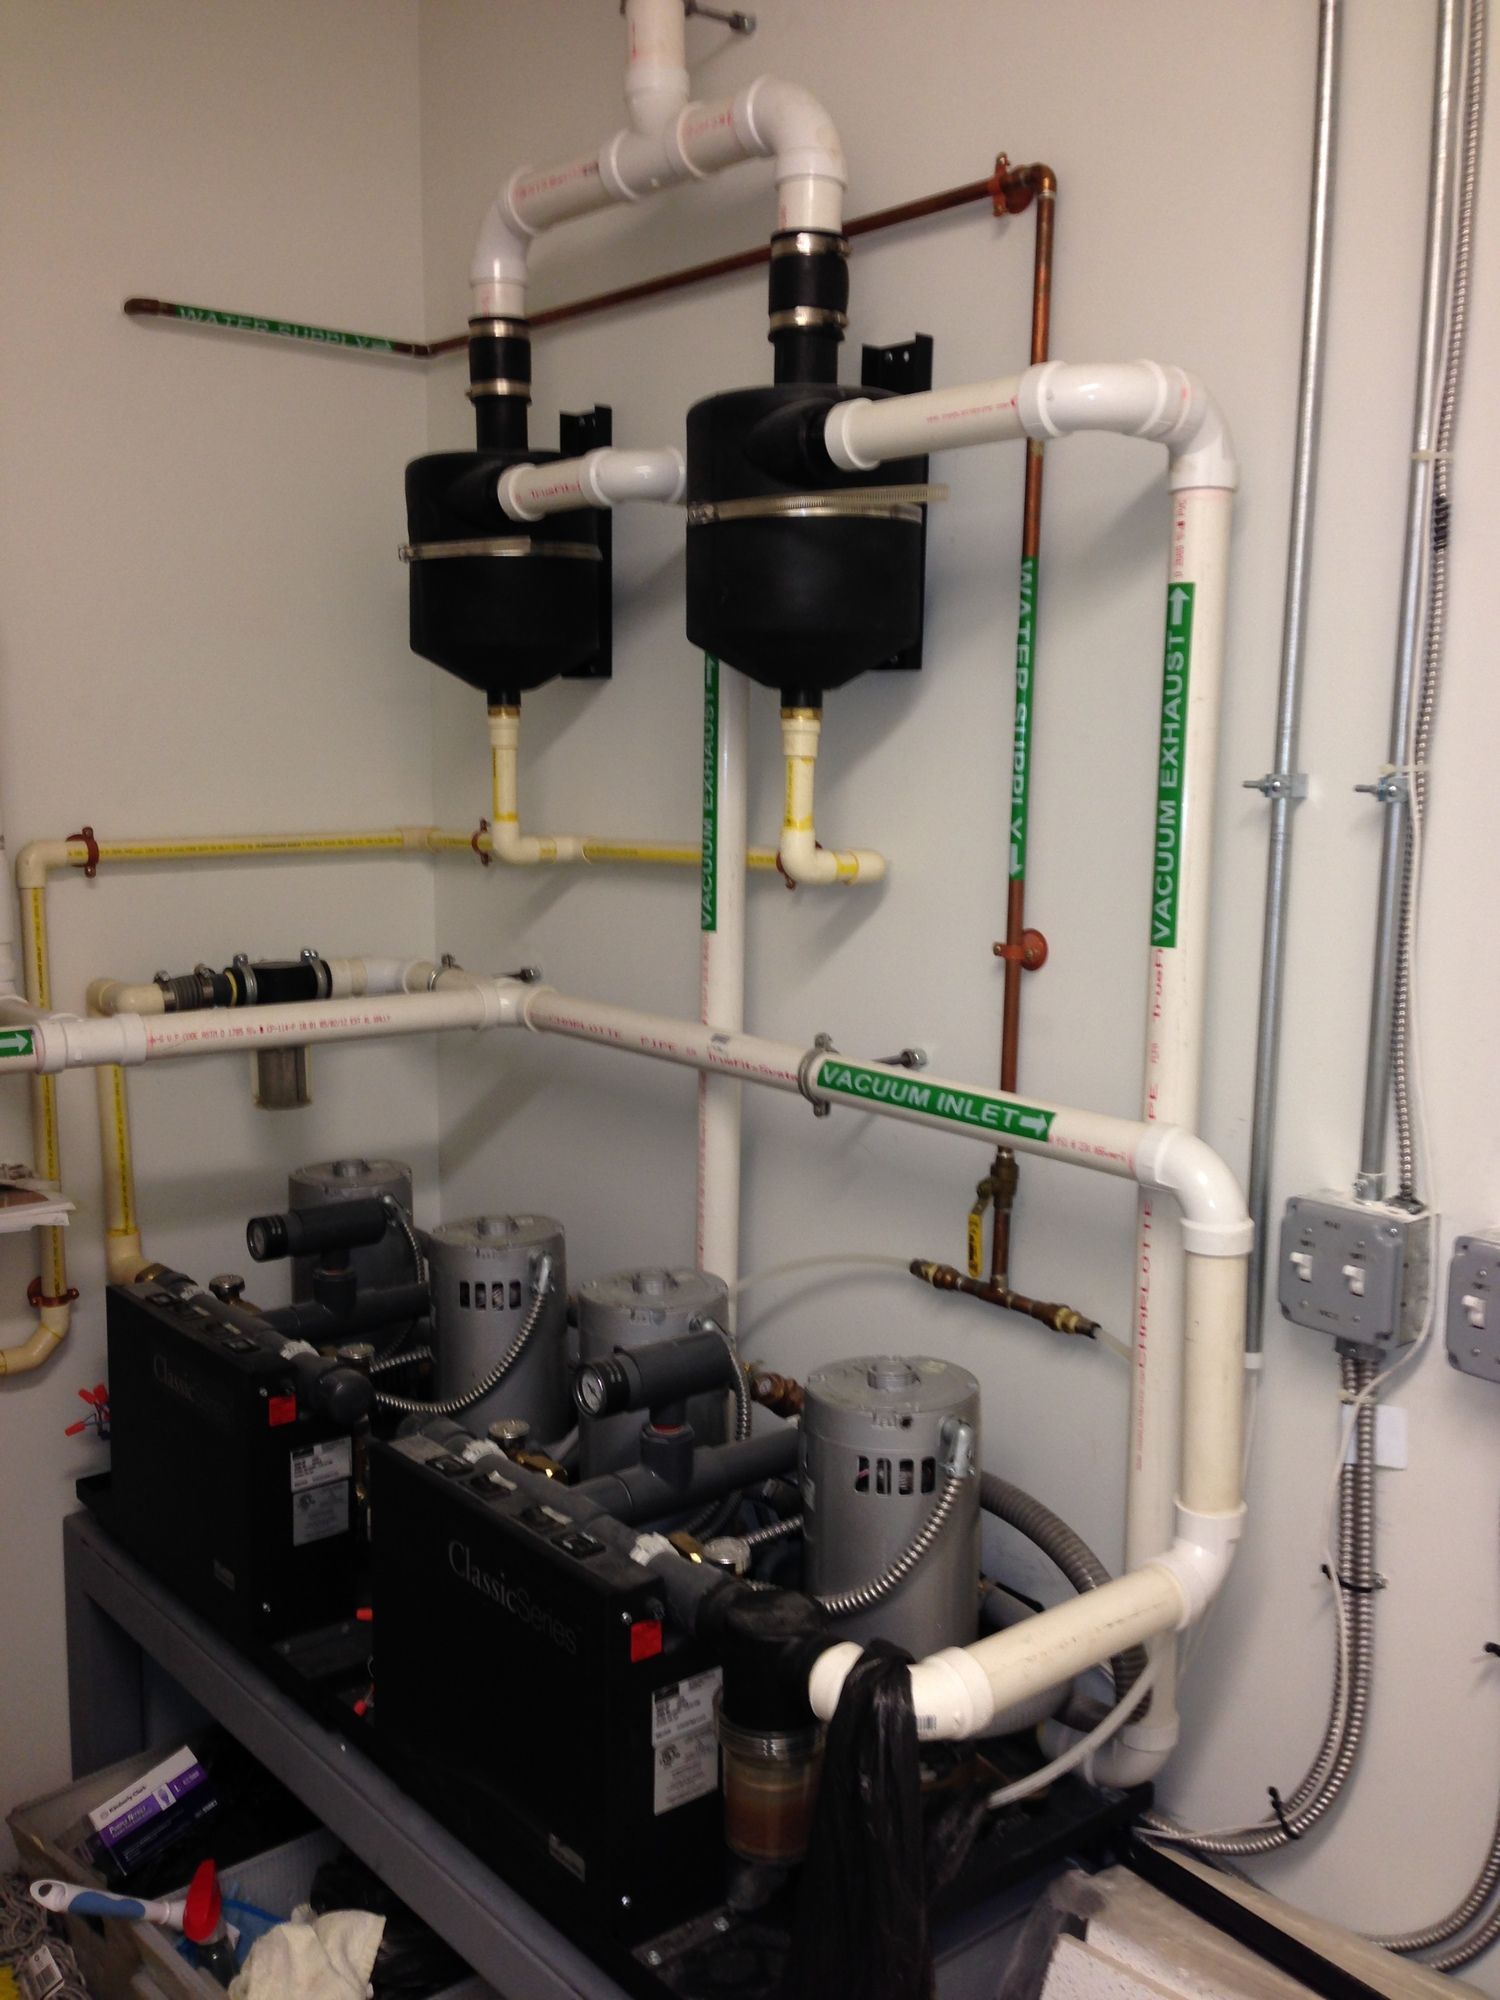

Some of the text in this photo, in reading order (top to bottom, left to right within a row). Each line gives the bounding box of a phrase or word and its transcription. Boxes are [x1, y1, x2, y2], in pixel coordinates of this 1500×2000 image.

[178, 307, 372, 350] WATER SUPPLY
[1016, 560, 1034, 689] WATER
[703, 692, 715, 811] EXHAUST
[1152, 630, 1186, 941] VACUUM EXHAUST
[701, 818, 714, 926] VACUUM
[822, 1063, 1022, 1128] VACUUM INLET
[448, 1539, 578, 1655] ClassicSeries
